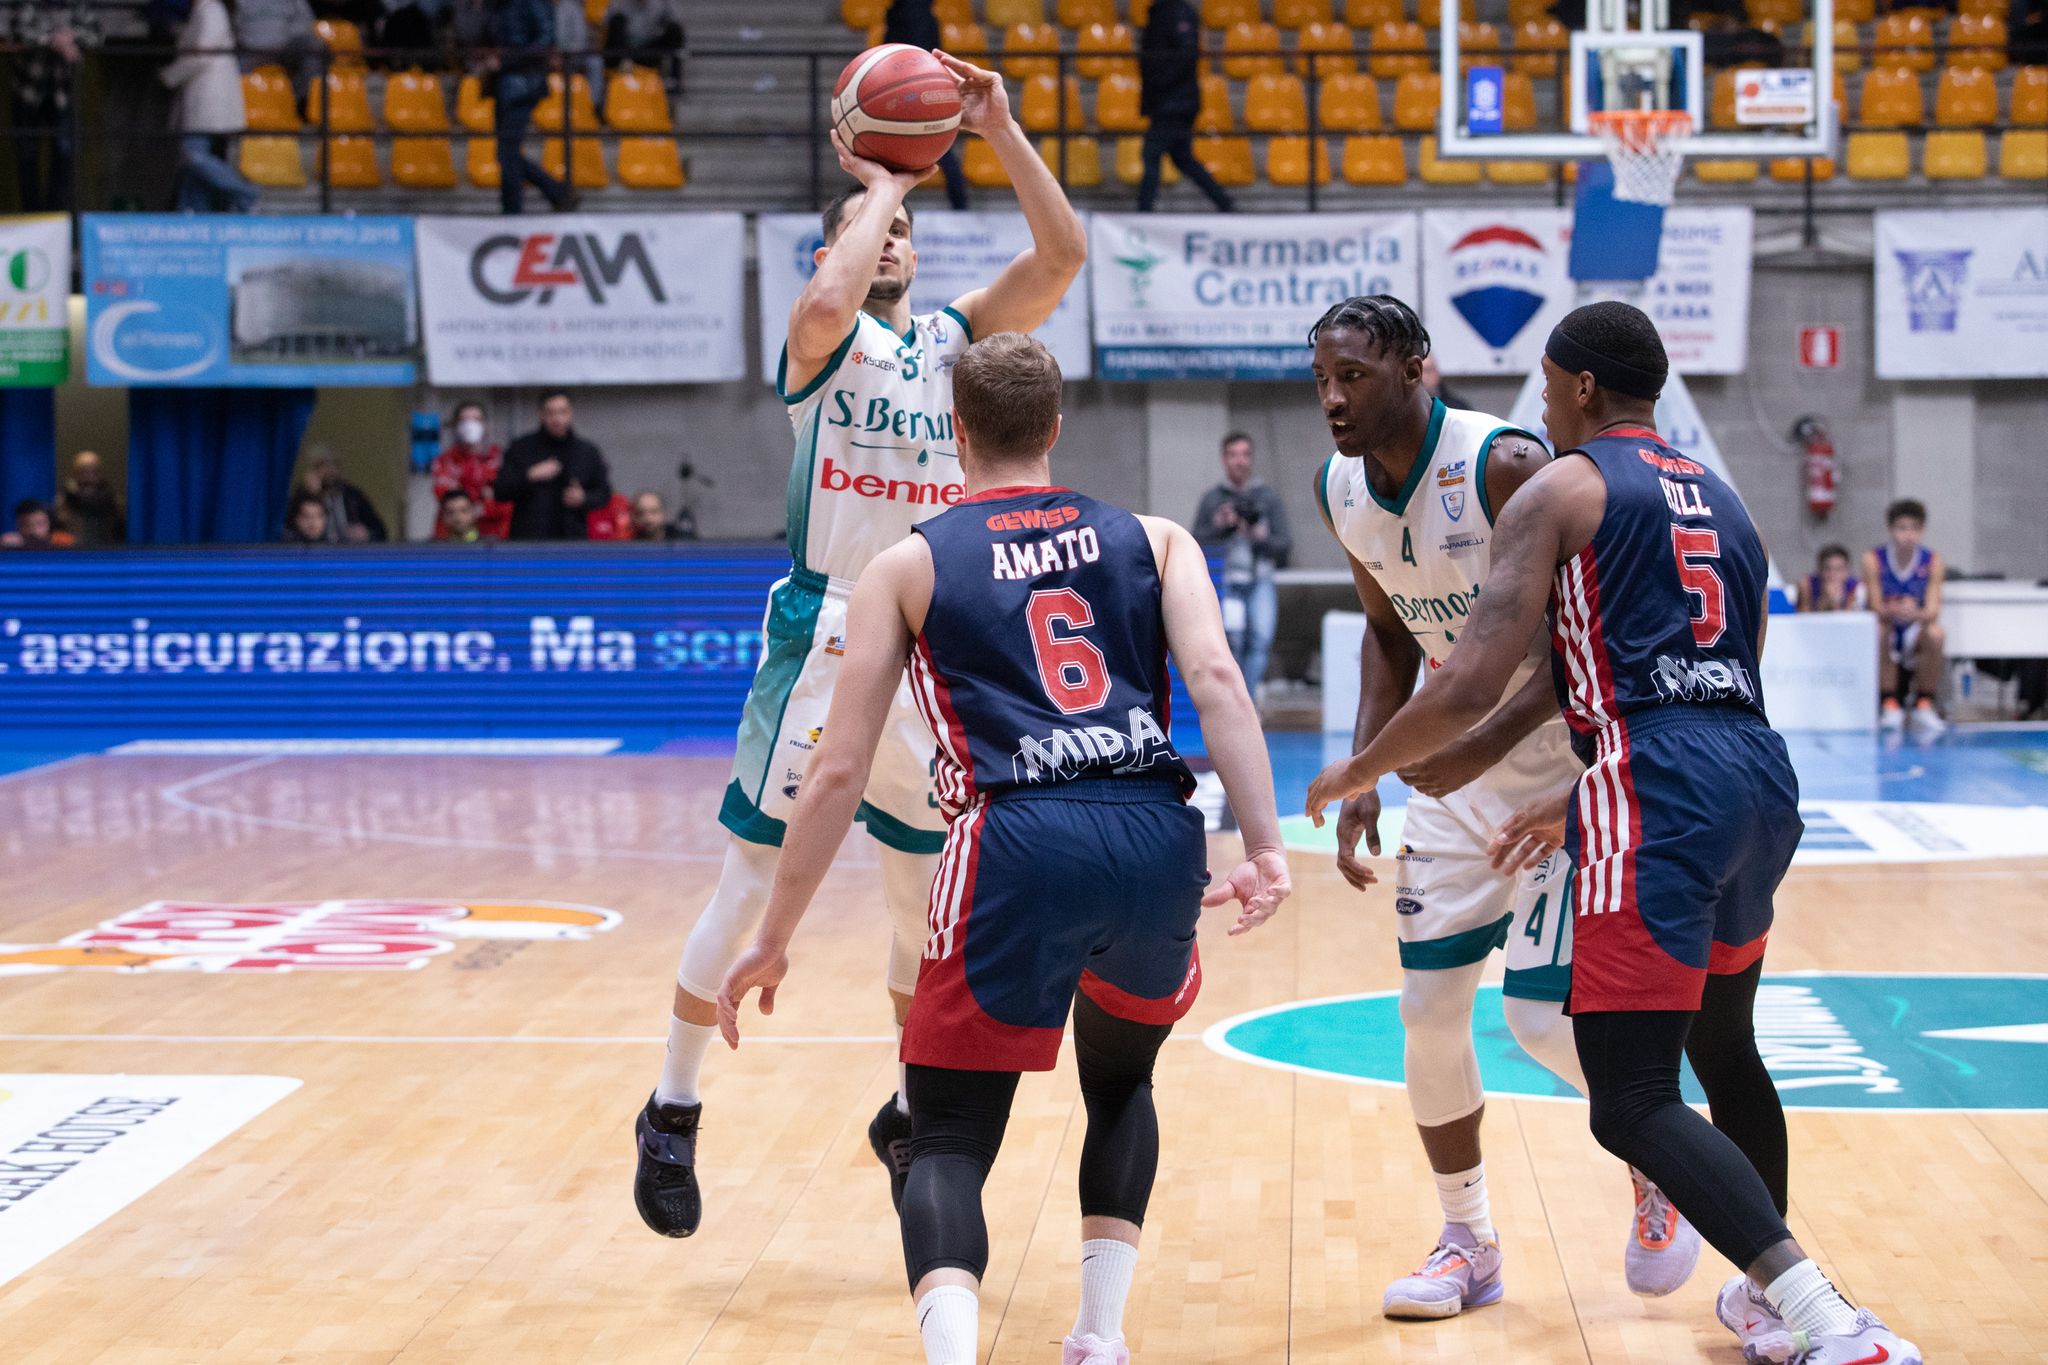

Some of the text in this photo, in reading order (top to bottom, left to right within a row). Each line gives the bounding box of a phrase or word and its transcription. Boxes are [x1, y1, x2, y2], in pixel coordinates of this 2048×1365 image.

[470, 232, 668, 305] CEAM
[1183, 231, 1402, 268] Farmacia
[1194, 268, 1392, 306] Centrale
[862, 352, 897, 372] KYOCER
[820, 457, 967, 506] benne
[1658, 476, 1713, 517] HILL
[991, 526, 1101, 580] AMATO
[1401, 526, 1418, 567] 4
[1438, 536, 1485, 551] PAPARELLI
[1670, 522, 1727, 648] 5
[529, 615, 637, 672] Ma
[1025, 586, 1113, 716] 6
[1523, 892, 1548, 946] 4
[10, 1096, 182, 1154] HOUSE
